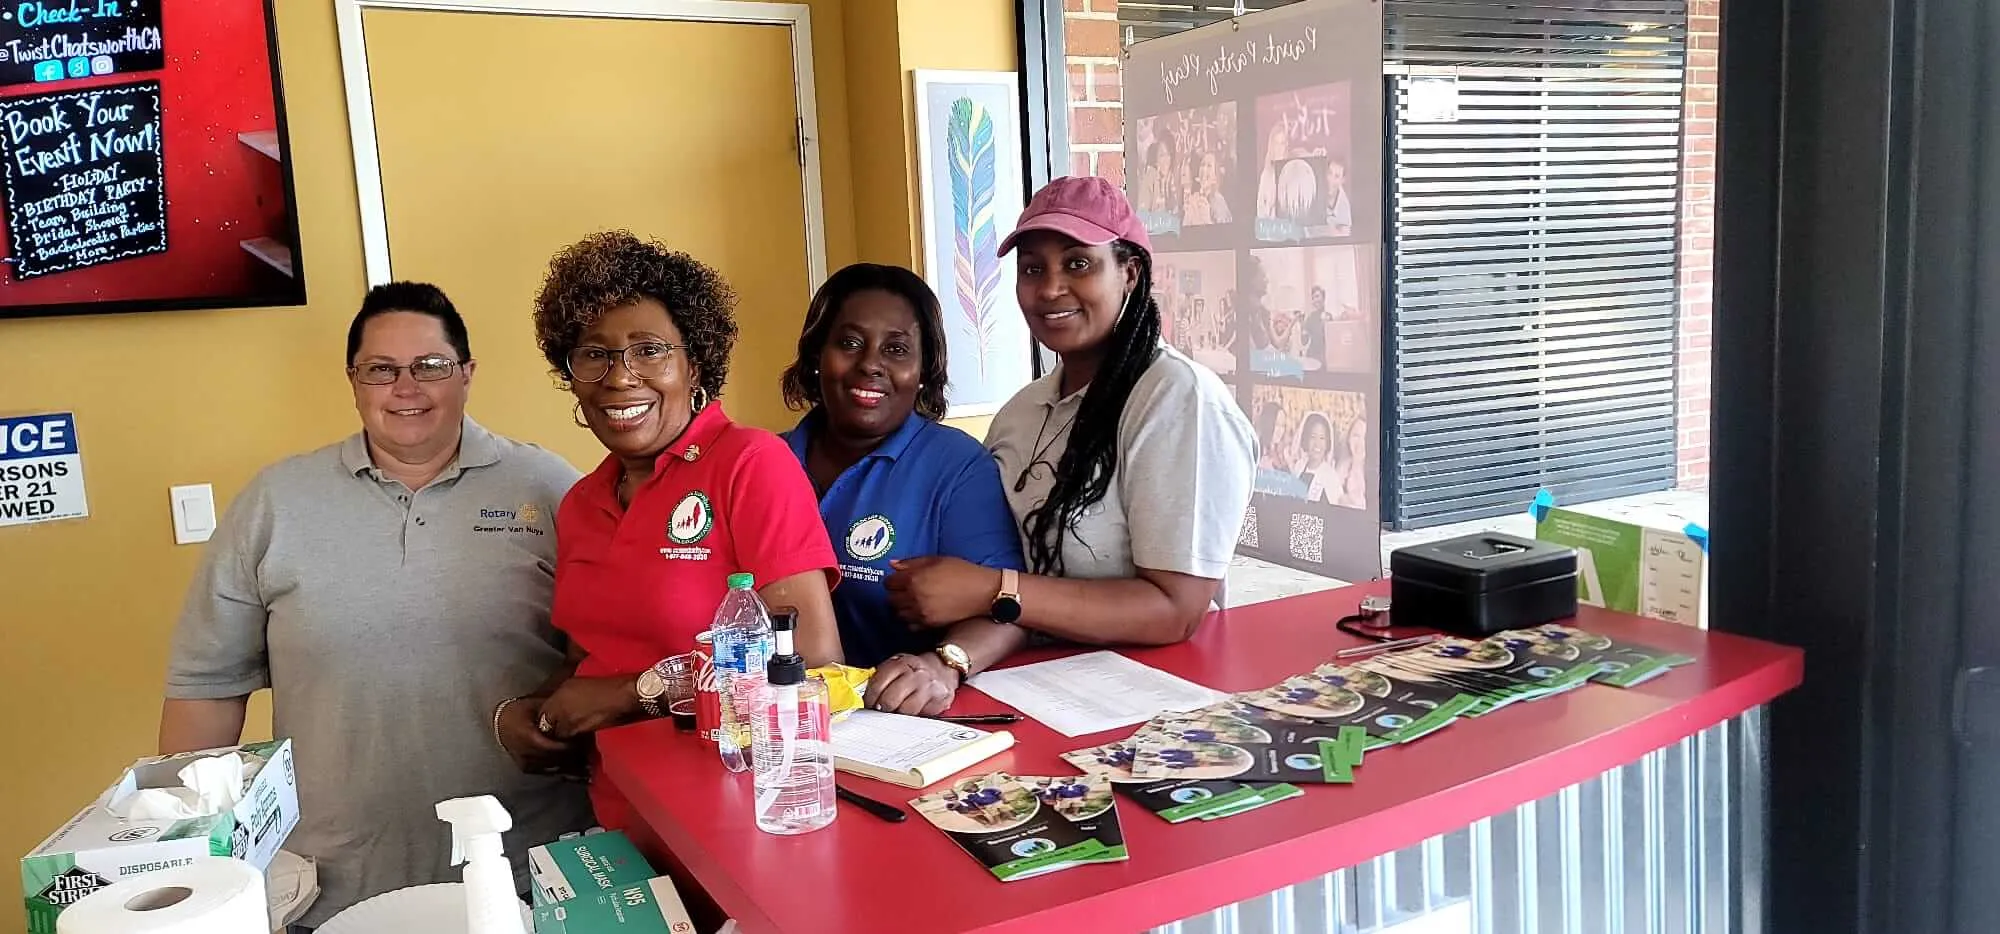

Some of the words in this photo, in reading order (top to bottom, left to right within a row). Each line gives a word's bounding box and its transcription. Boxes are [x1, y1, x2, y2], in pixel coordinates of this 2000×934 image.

[18, 0, 122, 27] Check-In
[0, 27, 162, 64] @TwistChatsworthCA
[5, 102, 72, 144] Book
[76, 95, 134, 127] Your
[90, 123, 153, 161] Now!
[24, 187, 96, 217] BIRTHDAY
[105, 177, 146, 200] PARTY
[28, 214, 66, 231] Team
[71, 202, 127, 222] Building
[32, 224, 79, 247] Bridal
[85, 214, 130, 234] Shower
[36, 230, 119, 261] Bachelorette
[120, 221, 156, 238] Parties
[75, 246, 108, 261] More
[27, 480, 57, 497] 21
[0, 499, 55, 518] WED
[480, 508, 517, 520] Rotary
[473, 525, 505, 533] Greater
[526, 525, 544, 536] Nuys
[574, 845, 601, 873] SURGICAL
[592, 871, 613, 890] MASK
[52, 872, 100, 892] FIRST
[48, 886, 101, 906] STRE
[623, 887, 648, 907] N95
